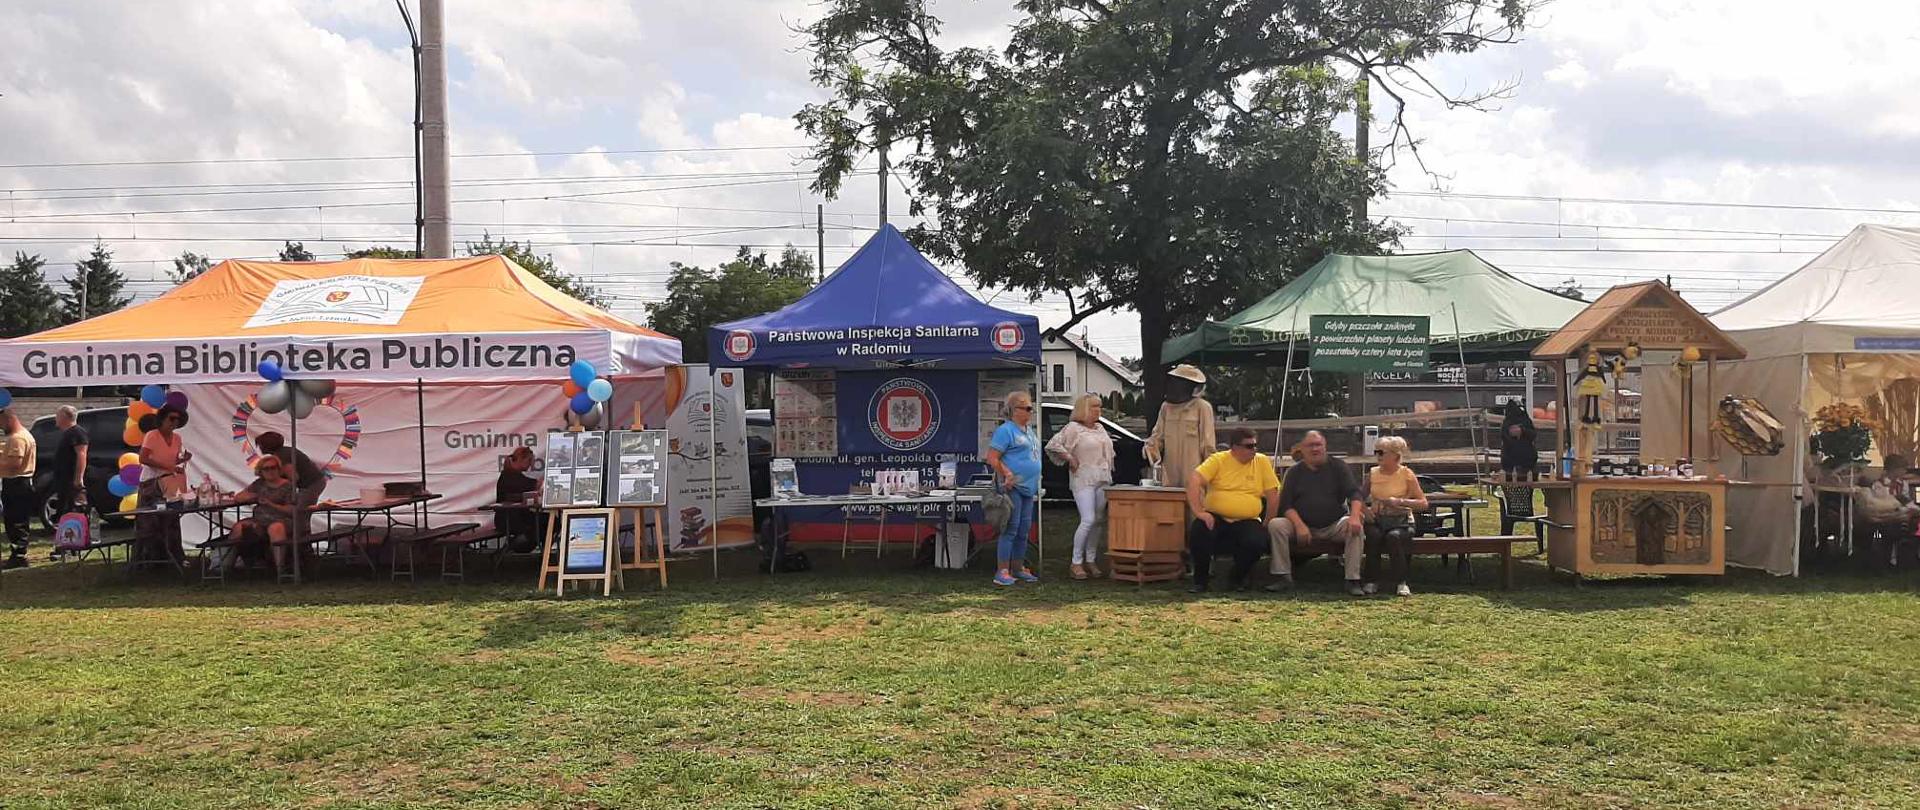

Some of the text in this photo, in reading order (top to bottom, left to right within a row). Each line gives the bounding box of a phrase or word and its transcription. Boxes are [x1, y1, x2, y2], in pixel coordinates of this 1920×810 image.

[769, 325, 980, 342] Państwowa Inspekcja Sanitarna
[1324, 321, 1348, 332] Gdyby
[837, 342, 911, 356] w Radomiu
[23, 336, 577, 379] Gminna Biblioteka Publiczna
[444, 429, 537, 448] Gminna
[854, 455, 878, 465] gen.
[880, 453, 931, 465] Leopolda
